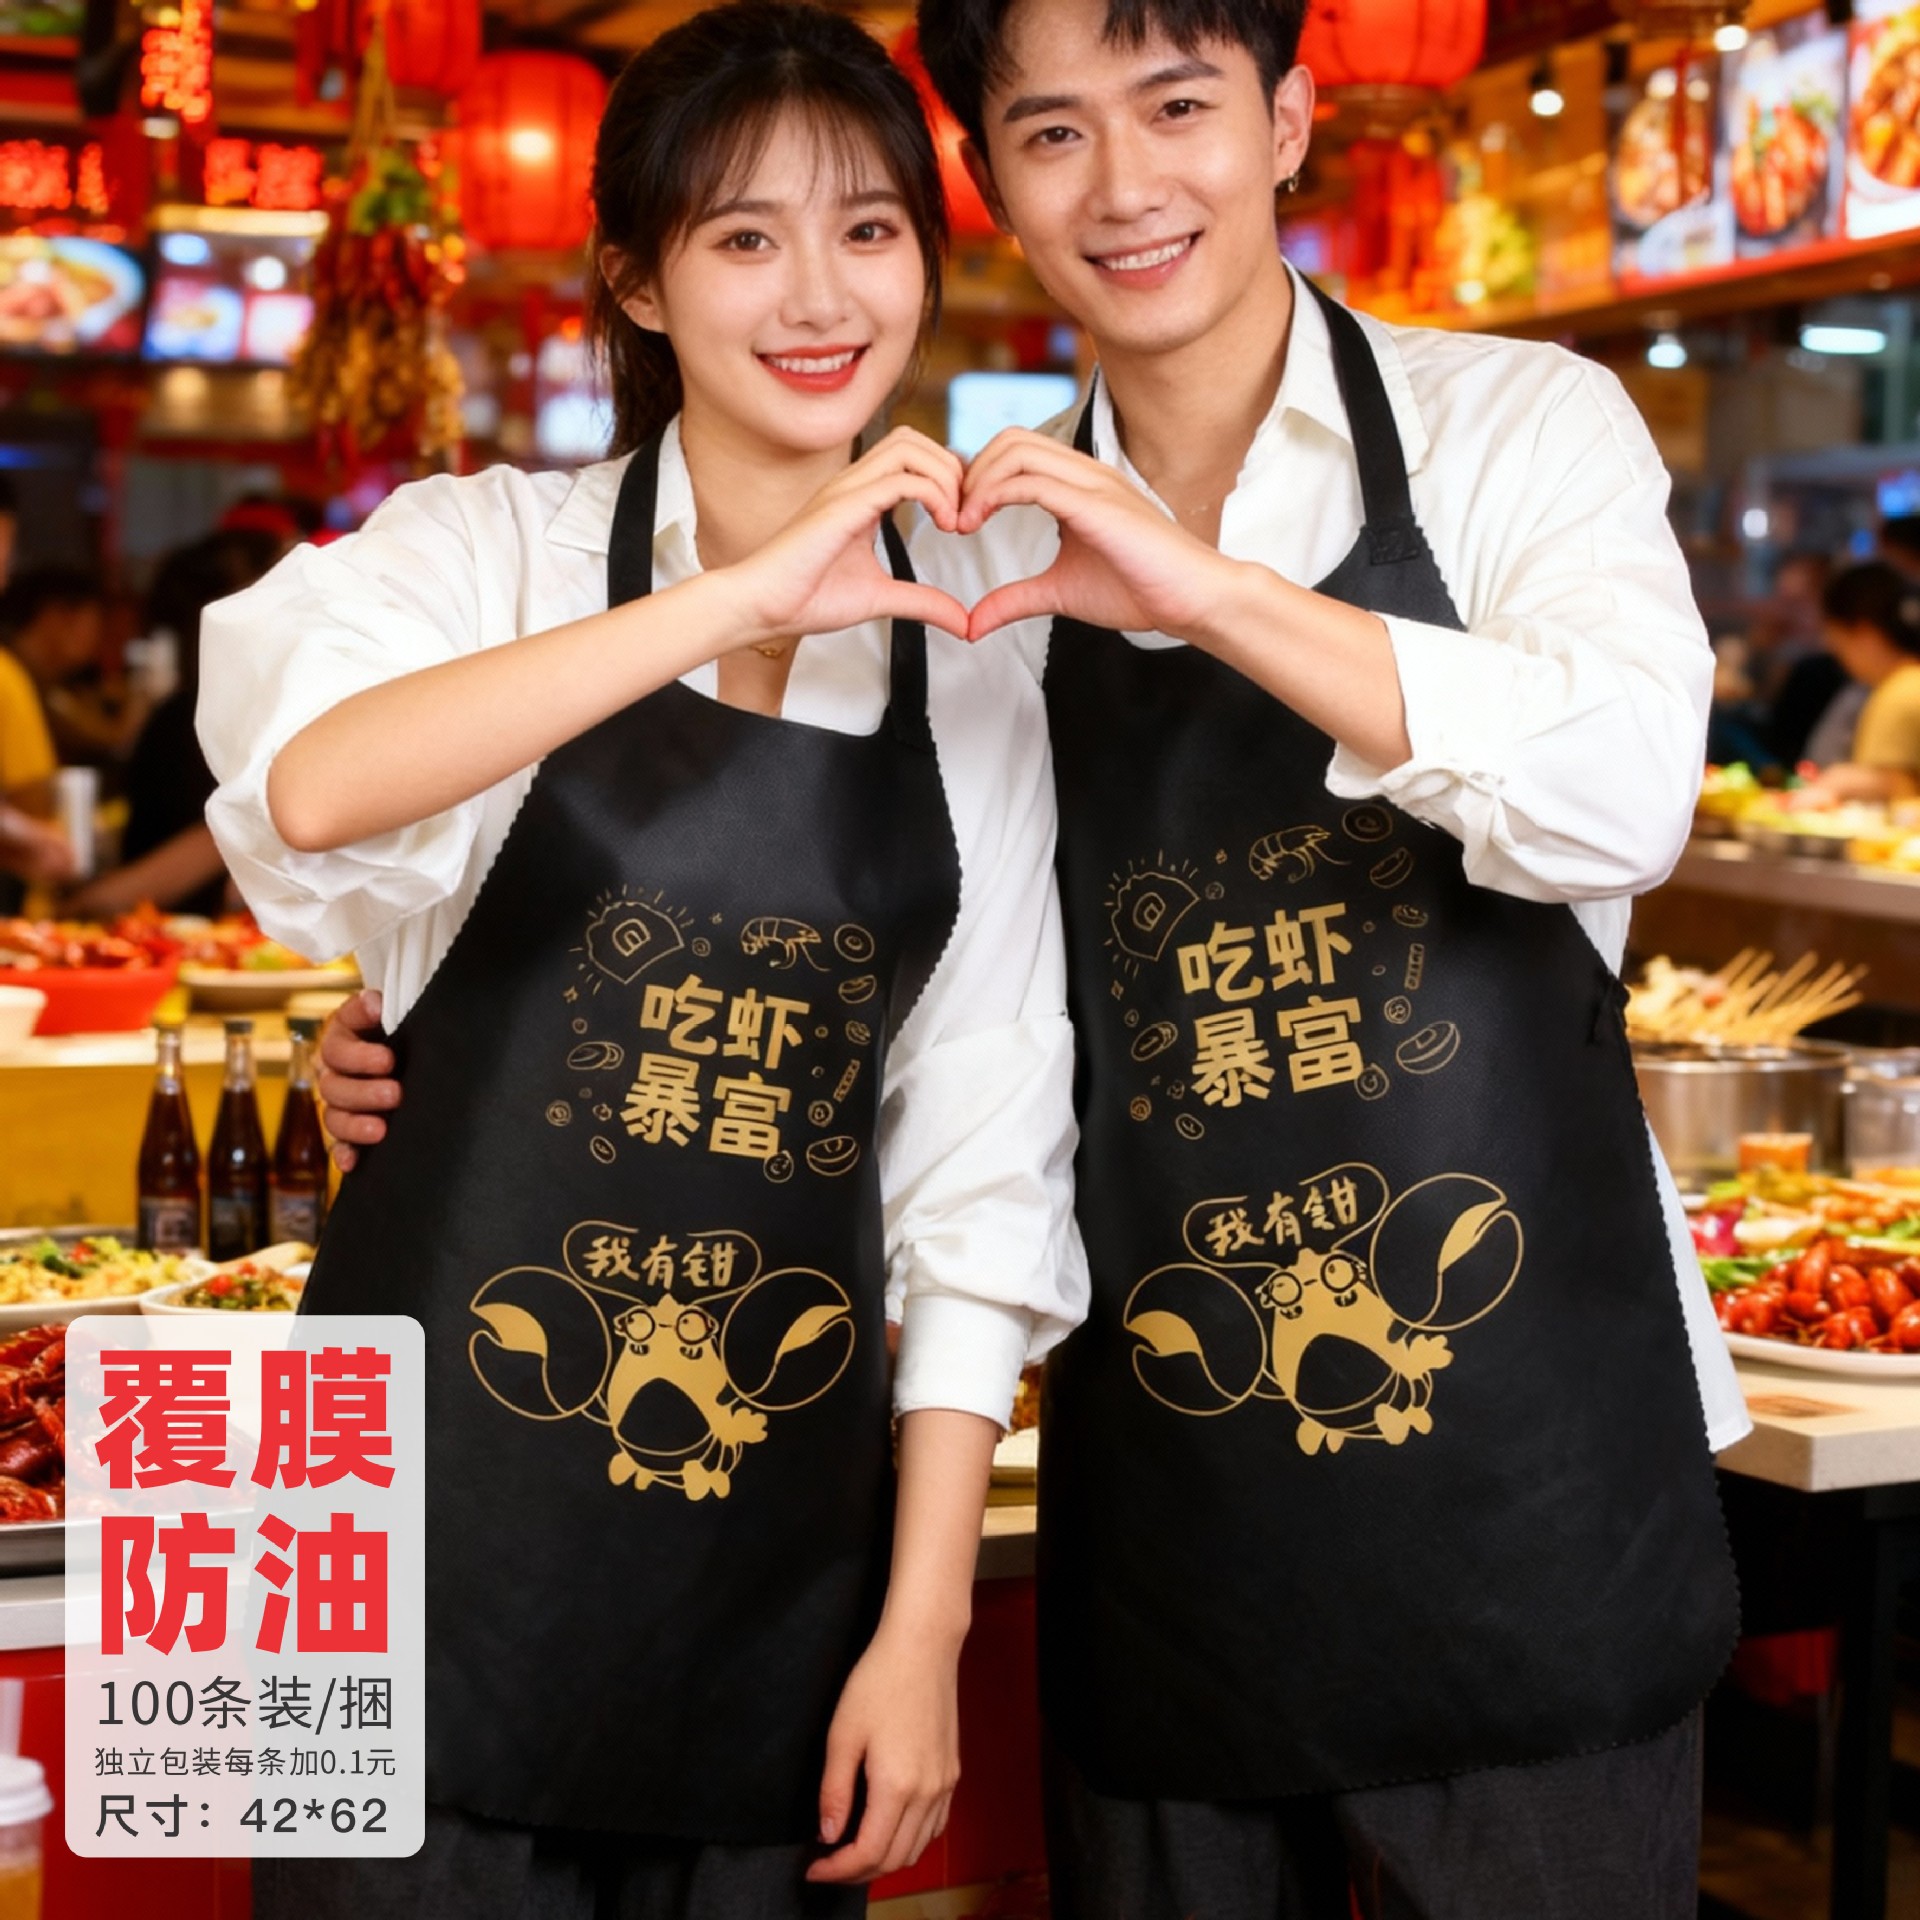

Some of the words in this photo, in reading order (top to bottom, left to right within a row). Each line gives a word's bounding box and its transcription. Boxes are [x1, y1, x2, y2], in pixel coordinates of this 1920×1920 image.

[1177, 903, 1353, 1002] 吃虾
[640, 974, 810, 1069] 吃虾
[1191, 996, 1364, 1108] 暴富
[620, 1053, 792, 1160] 暴富
